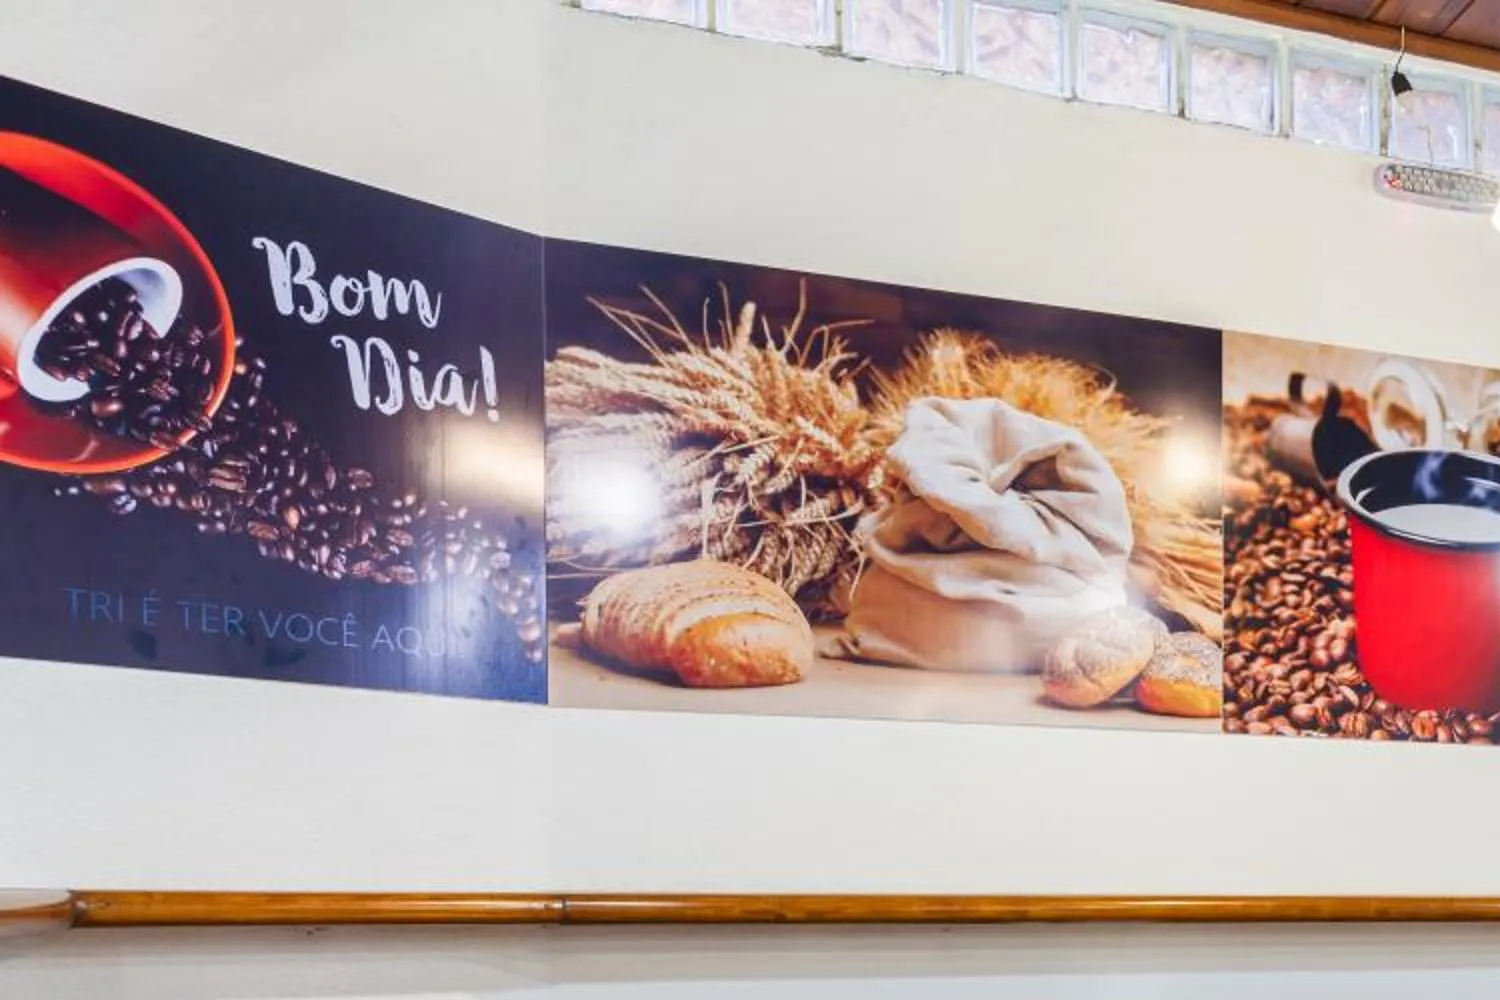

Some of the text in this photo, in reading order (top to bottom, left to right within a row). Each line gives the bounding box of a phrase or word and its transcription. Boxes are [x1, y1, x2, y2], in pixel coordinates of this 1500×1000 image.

[252, 236, 441, 329] Bom
[330, 334, 500, 422] Dia!
[64, 586, 124, 623] TRI
[142, 590, 160, 626] É
[175, 600, 245, 637] TER
[258, 611, 361, 648] VOCÊ
